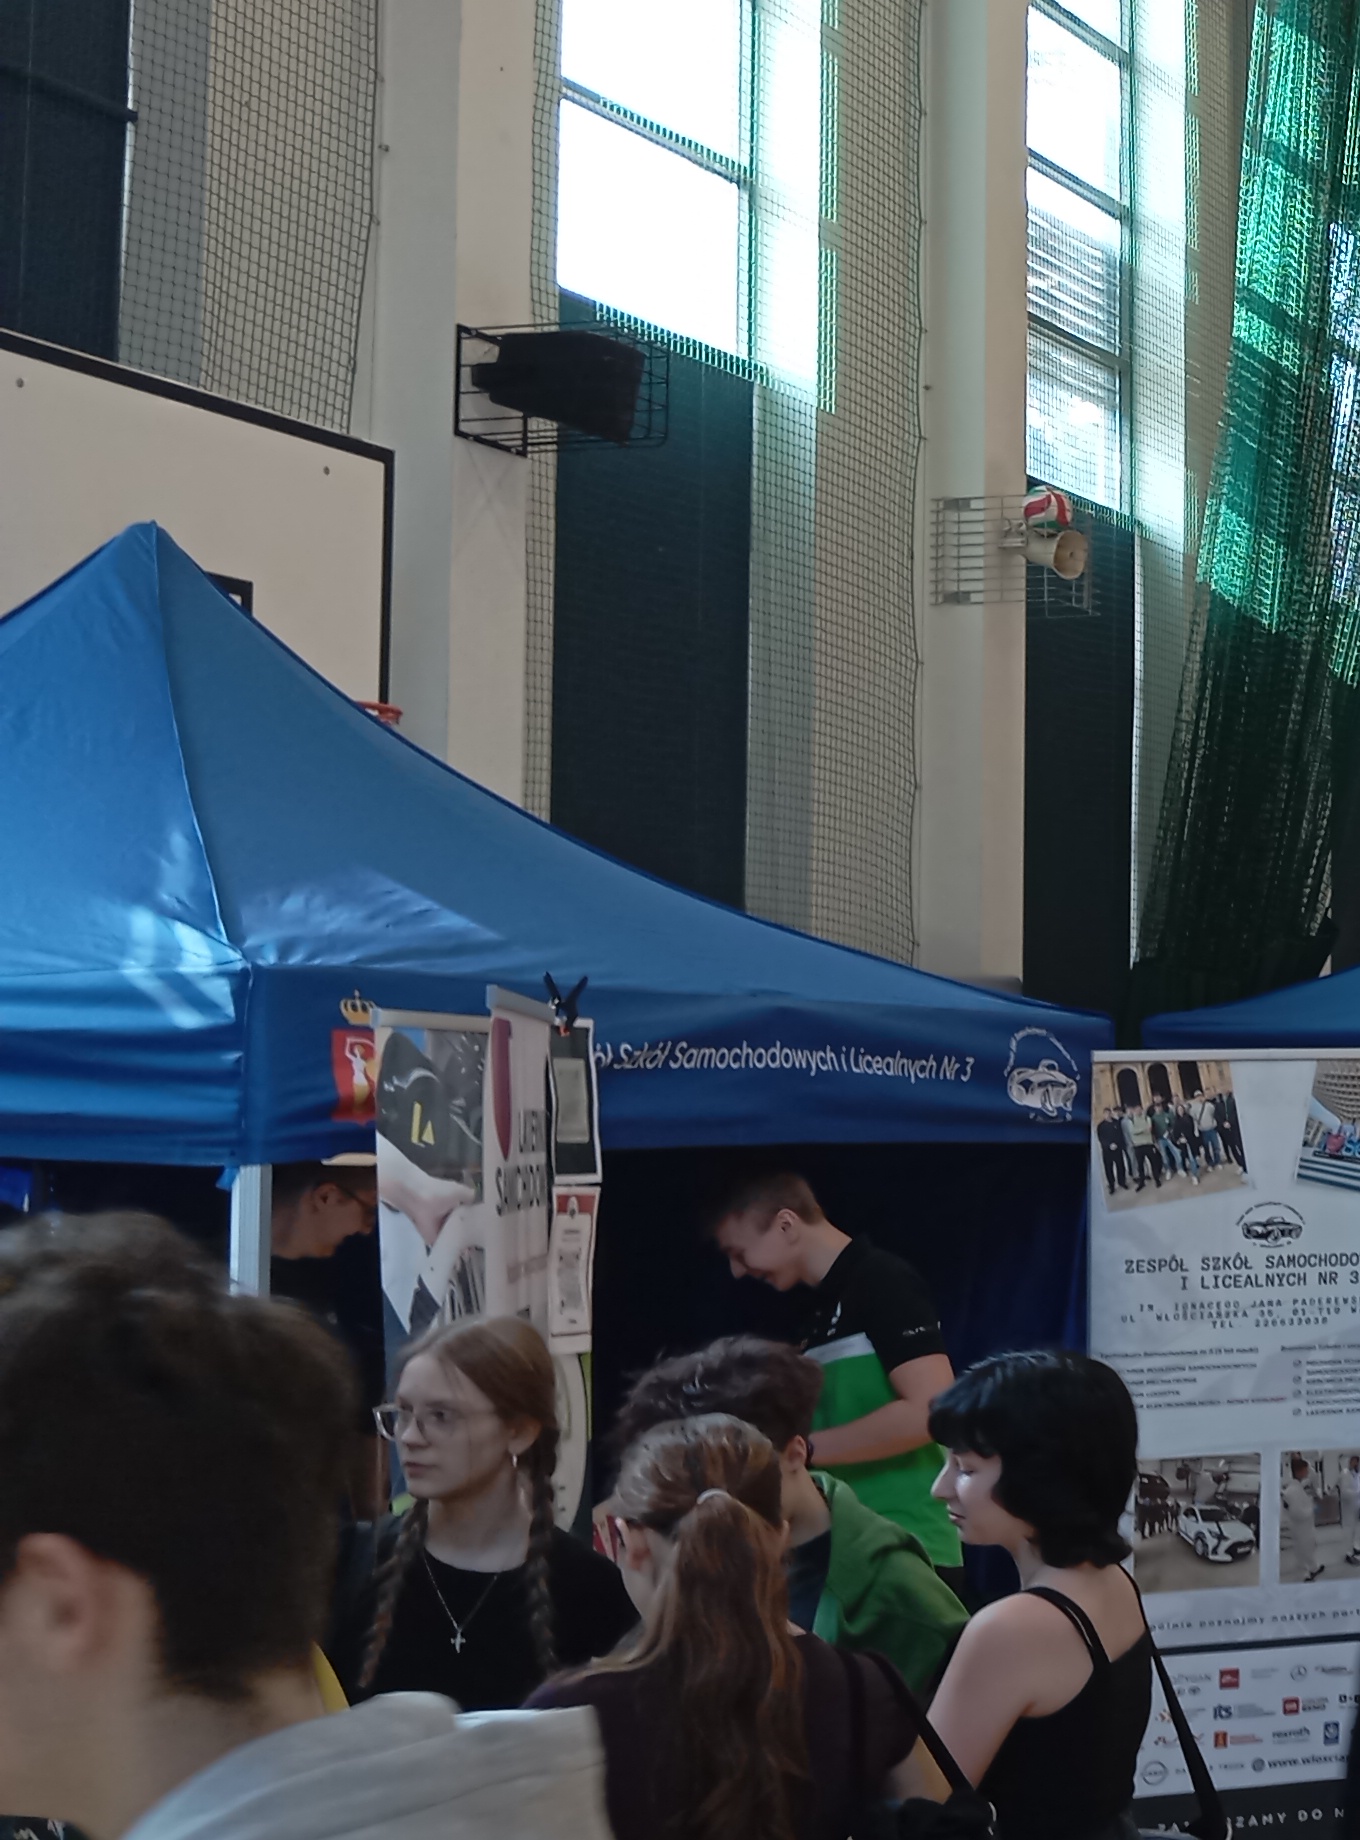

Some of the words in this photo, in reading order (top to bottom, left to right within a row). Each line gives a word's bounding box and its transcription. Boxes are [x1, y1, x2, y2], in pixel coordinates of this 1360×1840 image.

[614, 1041, 669, 1070] Szkół
[669, 1040, 840, 1077] Samochodowych
[841, 1045, 847, 1070] i
[850, 1047, 937, 1084] Licealnych
[939, 1054, 959, 1081] Nr
[960, 1057, 975, 1082] 3
[1124, 1254, 1189, 1274] ZESPÓŁ
[1201, 1252, 1253, 1271] SZKÓŁ
[1180, 1276, 1189, 1291] I
[1200, 1273, 1307, 1290] LICEALNYCH
[1317, 1272, 1338, 1285] NR
[1349, 1271, 1360, 1285] 3
[1174, 1300, 1240, 1312] IGNACEGO
[1252, 1299, 1283, 1309] JANA
